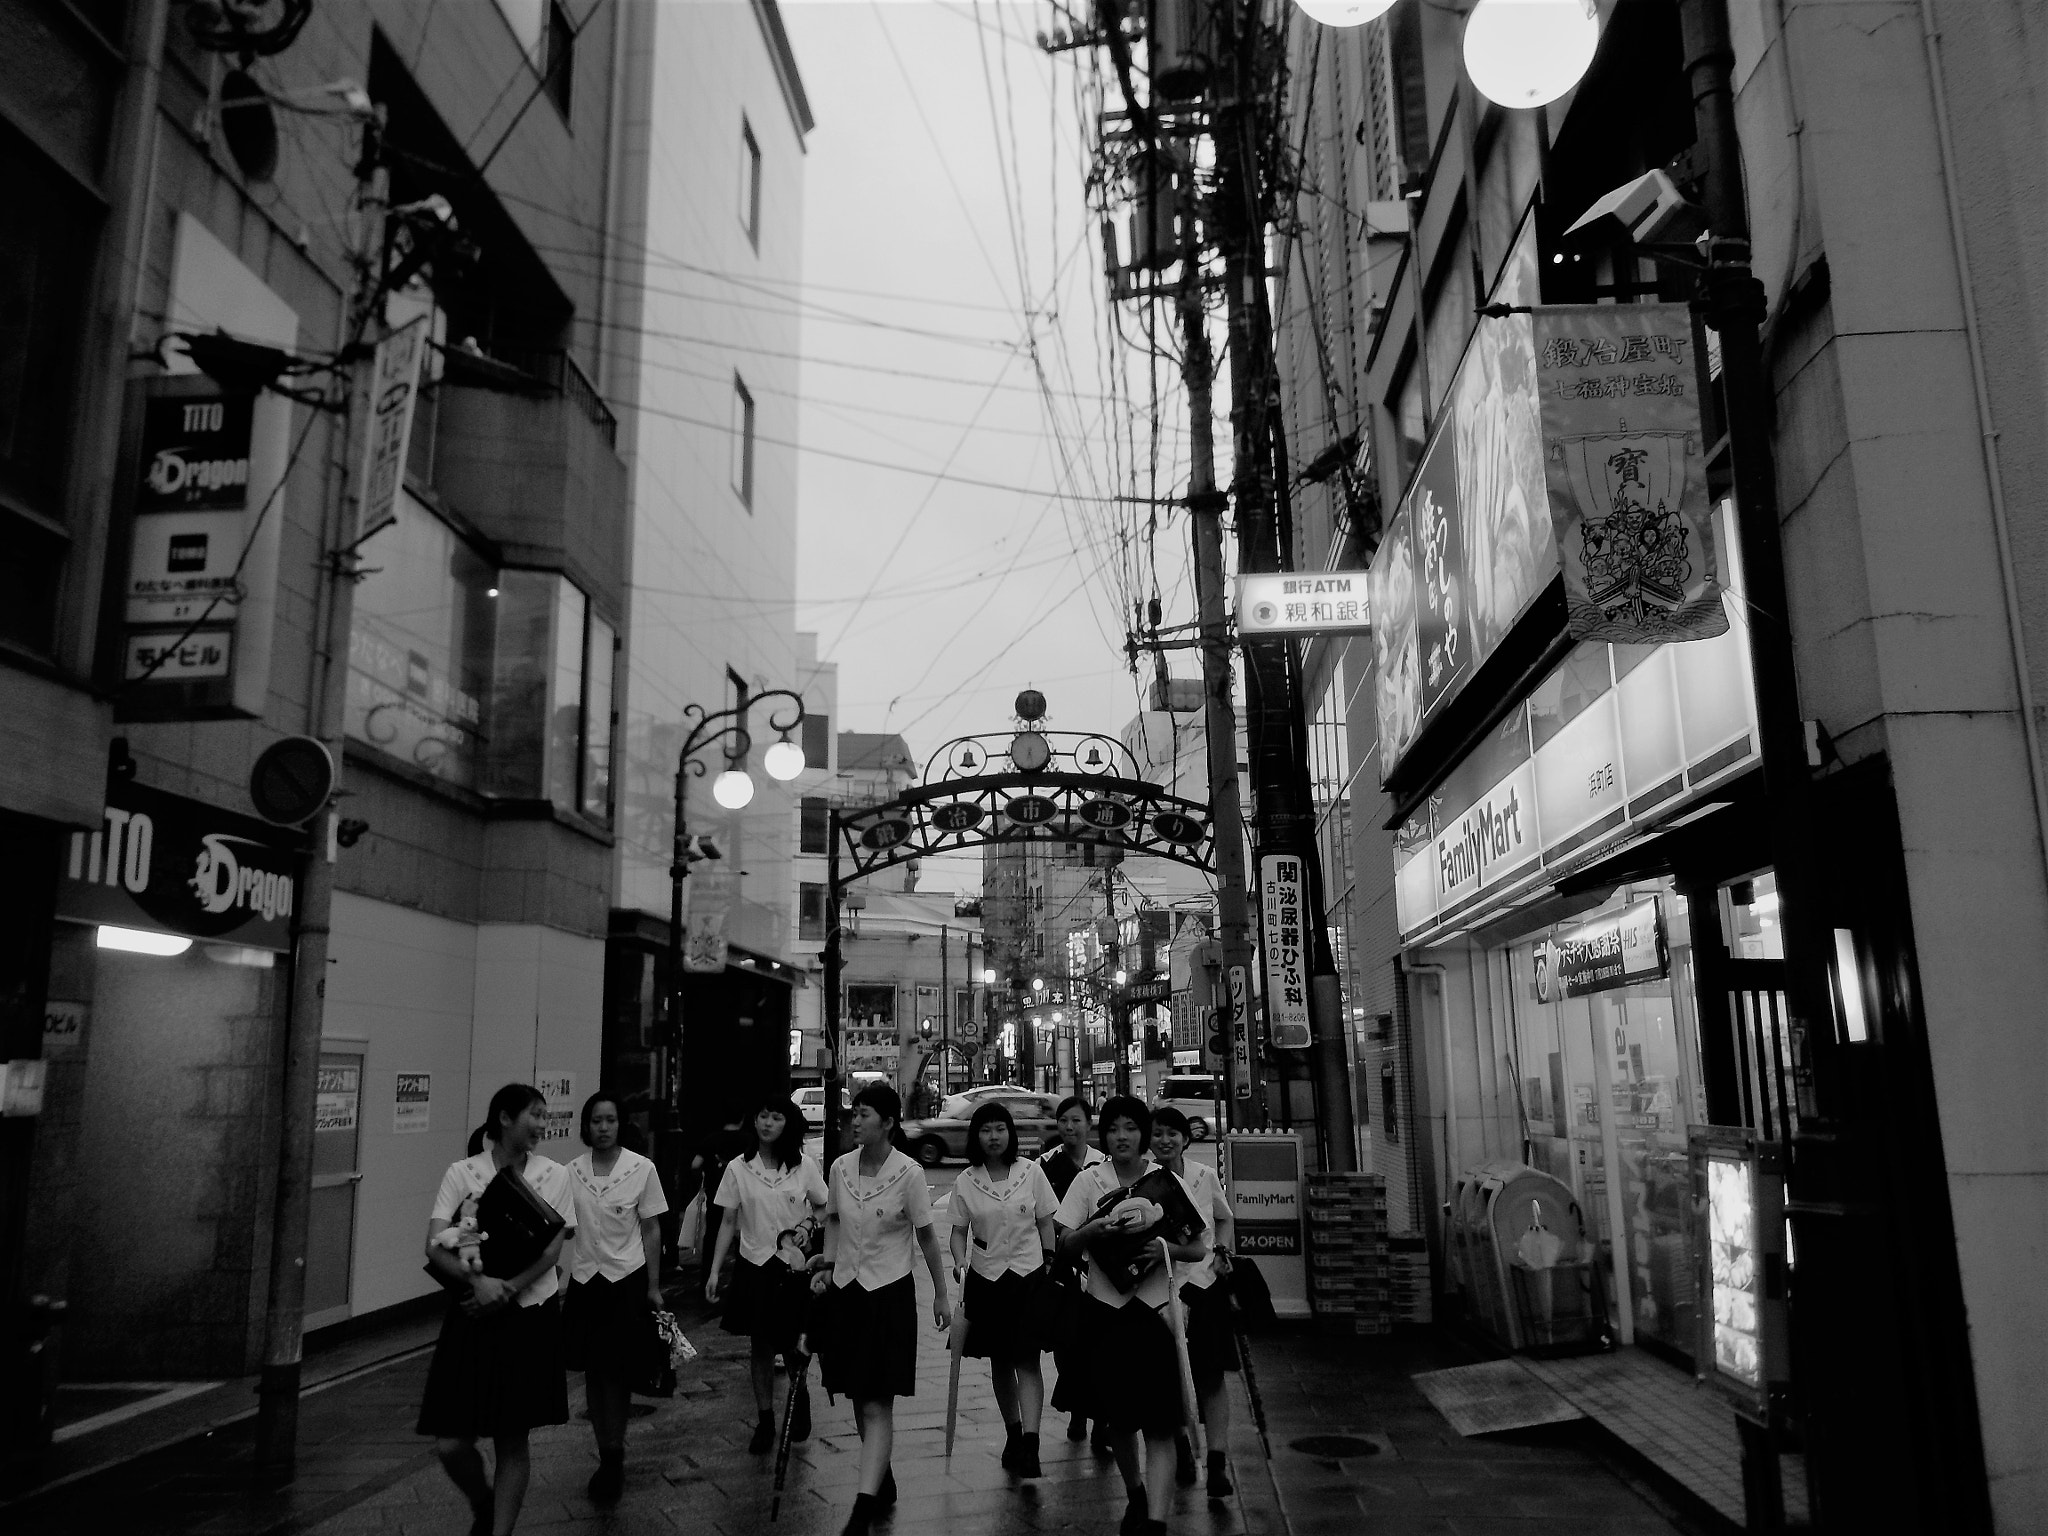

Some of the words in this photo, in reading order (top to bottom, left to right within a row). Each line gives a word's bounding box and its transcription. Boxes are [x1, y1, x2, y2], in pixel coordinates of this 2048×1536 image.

[1543, 335, 1687, 367] 鍛冶屋町
[1552, 373, 1685, 400] 七福神宝船
[183, 403, 223, 432] TITO
[145, 446, 247, 494] Dragon
[1283, 579, 1351, 594] 銀行ATM
[1588, 763, 1614, 799] 浜町店
[1438, 785, 1522, 894] FamilyMart
[188, 833, 293, 922] Drago
[1266, 880, 1281, 977] 古川町七の二
[1276, 860, 1304, 1007] 関泌尿器ひふ科
[1236, 1193, 1295, 1207] FamilyMart
[1240, 1235, 1256, 1248] 24
[1257, 1235, 1294, 1248] OPEN
